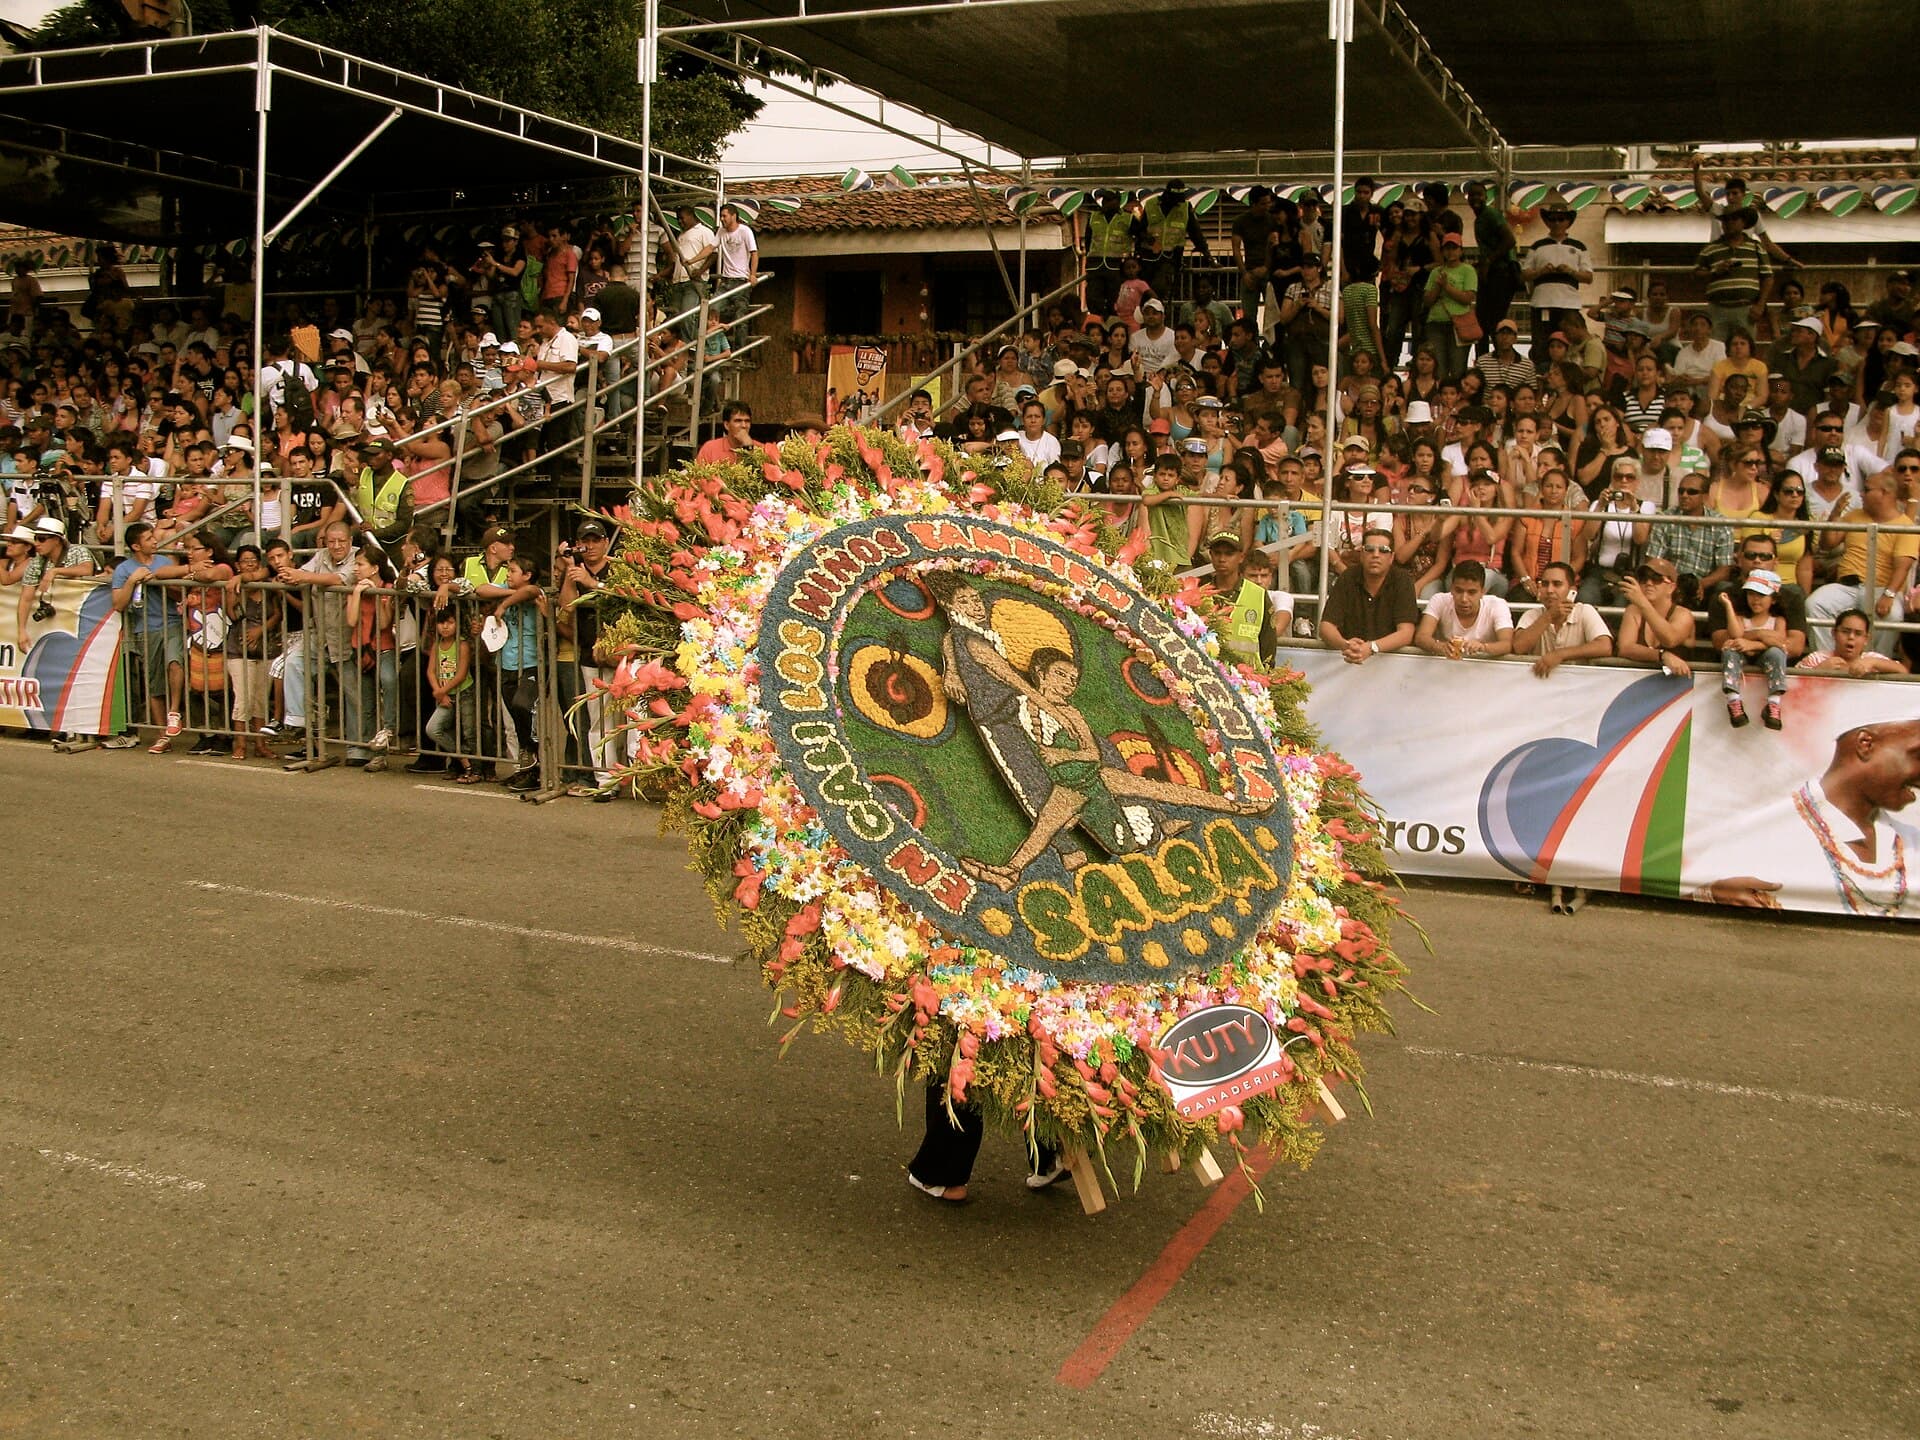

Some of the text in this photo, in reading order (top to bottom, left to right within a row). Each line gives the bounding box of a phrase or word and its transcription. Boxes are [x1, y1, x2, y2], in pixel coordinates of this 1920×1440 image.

[788, 527, 911, 620] NIÑOS
[903, 519, 1134, 612] TAMBIEN
[0, 679, 41, 707] TIR
[775, 619, 828, 711] LOS
[792, 721, 895, 841] CALI
[1231, 745, 1280, 803] LA
[1377, 820, 1466, 855] ros
[885, 838, 977, 915] EN
[1016, 819, 1279, 961] SALSA
[1164, 1013, 1256, 1075] KUTY
[1182, 1071, 1280, 1116] PANADERIA
